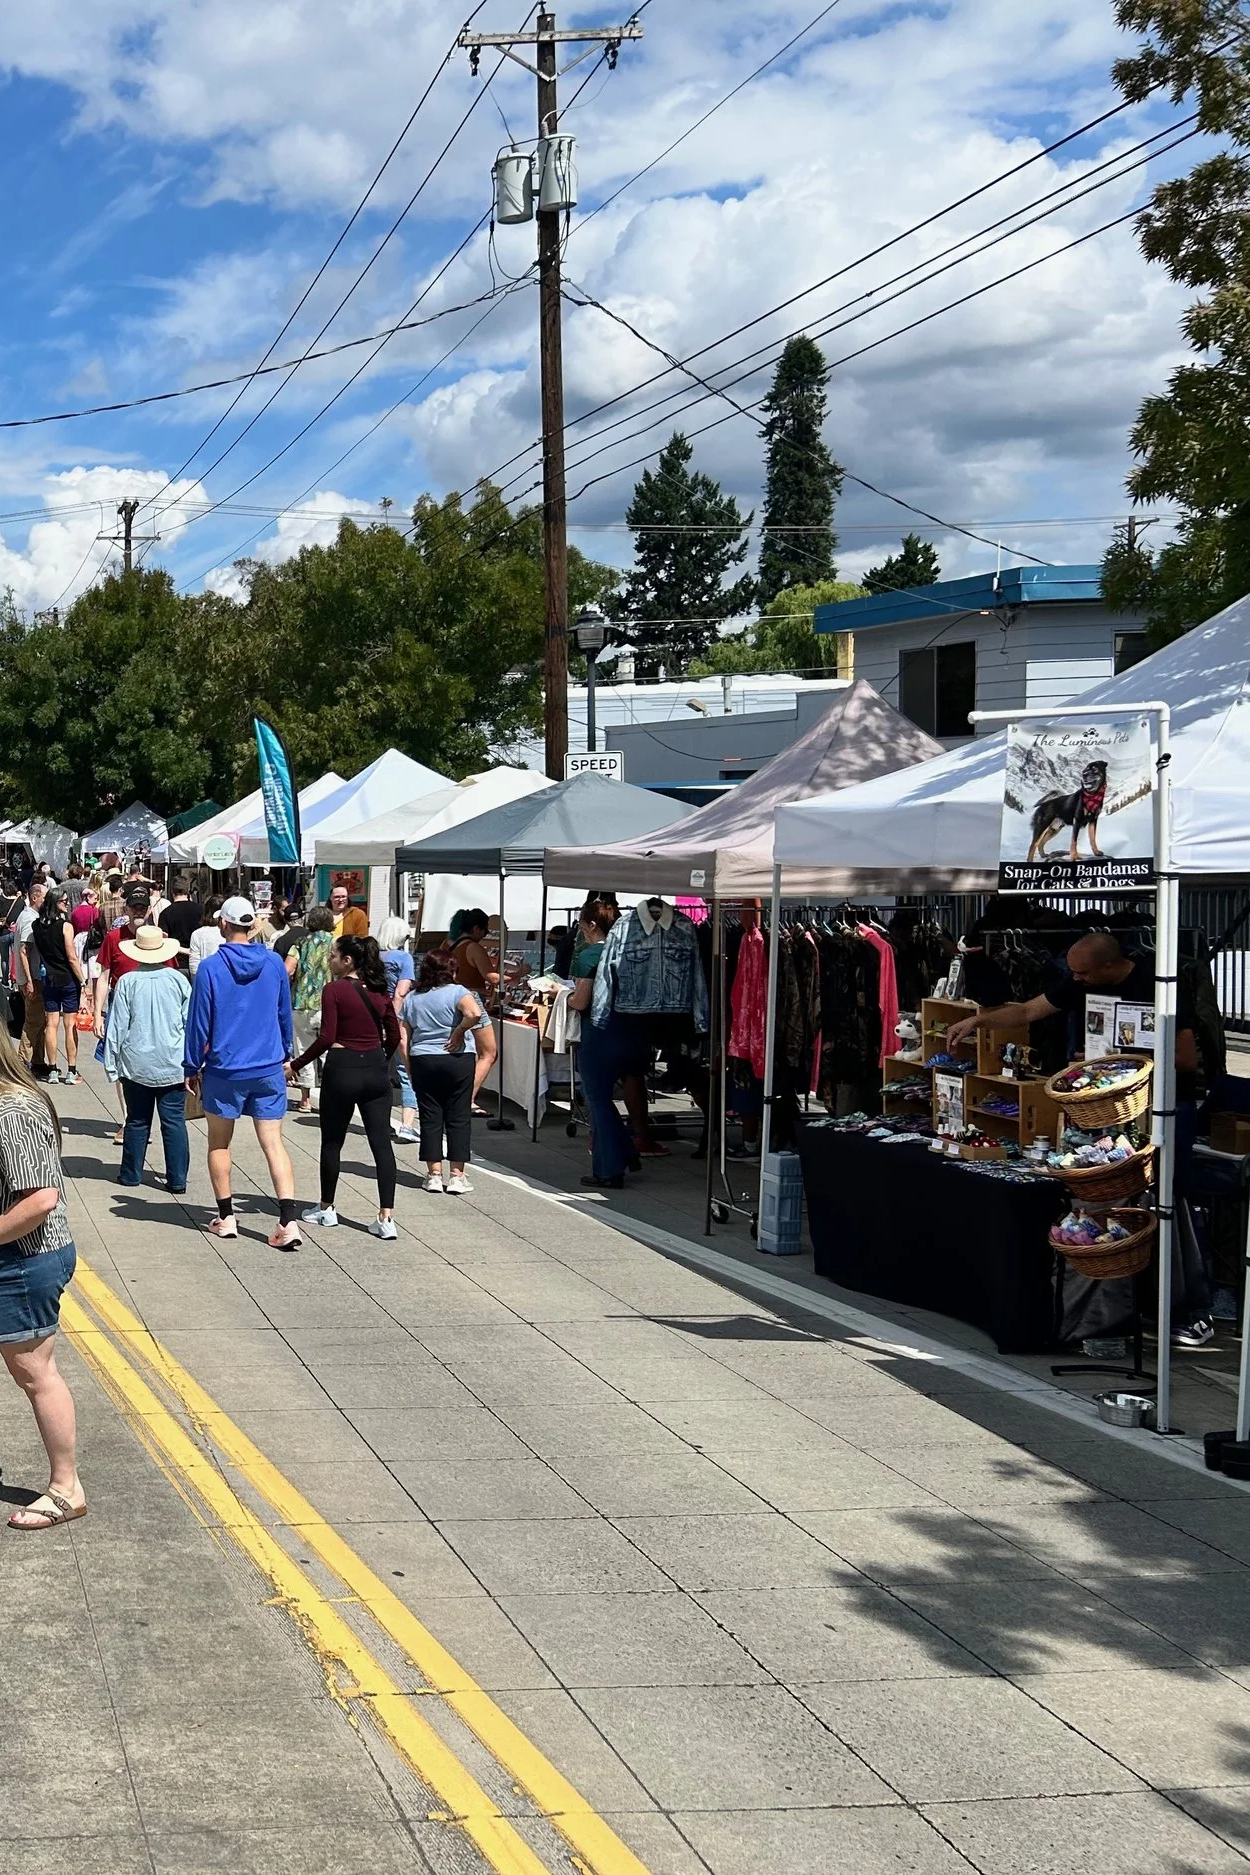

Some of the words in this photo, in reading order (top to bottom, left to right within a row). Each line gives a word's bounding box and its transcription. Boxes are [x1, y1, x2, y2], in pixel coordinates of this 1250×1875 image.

[1032, 733, 1055, 747] The
[1058, 734, 1111, 747] Luminous
[1113, 731, 1129, 744] Pets
[570, 758, 618, 771] SPEED
[263, 777, 277, 828] NETWORK
[1004, 865, 1071, 880] Snap-On
[1076, 862, 1149, 877] Bandanas
[1016, 878, 1038, 890] for
[1041, 878, 1074, 890] Cats
[1077, 877, 1092, 888] &
[1096, 876, 1136, 888] Dogs
